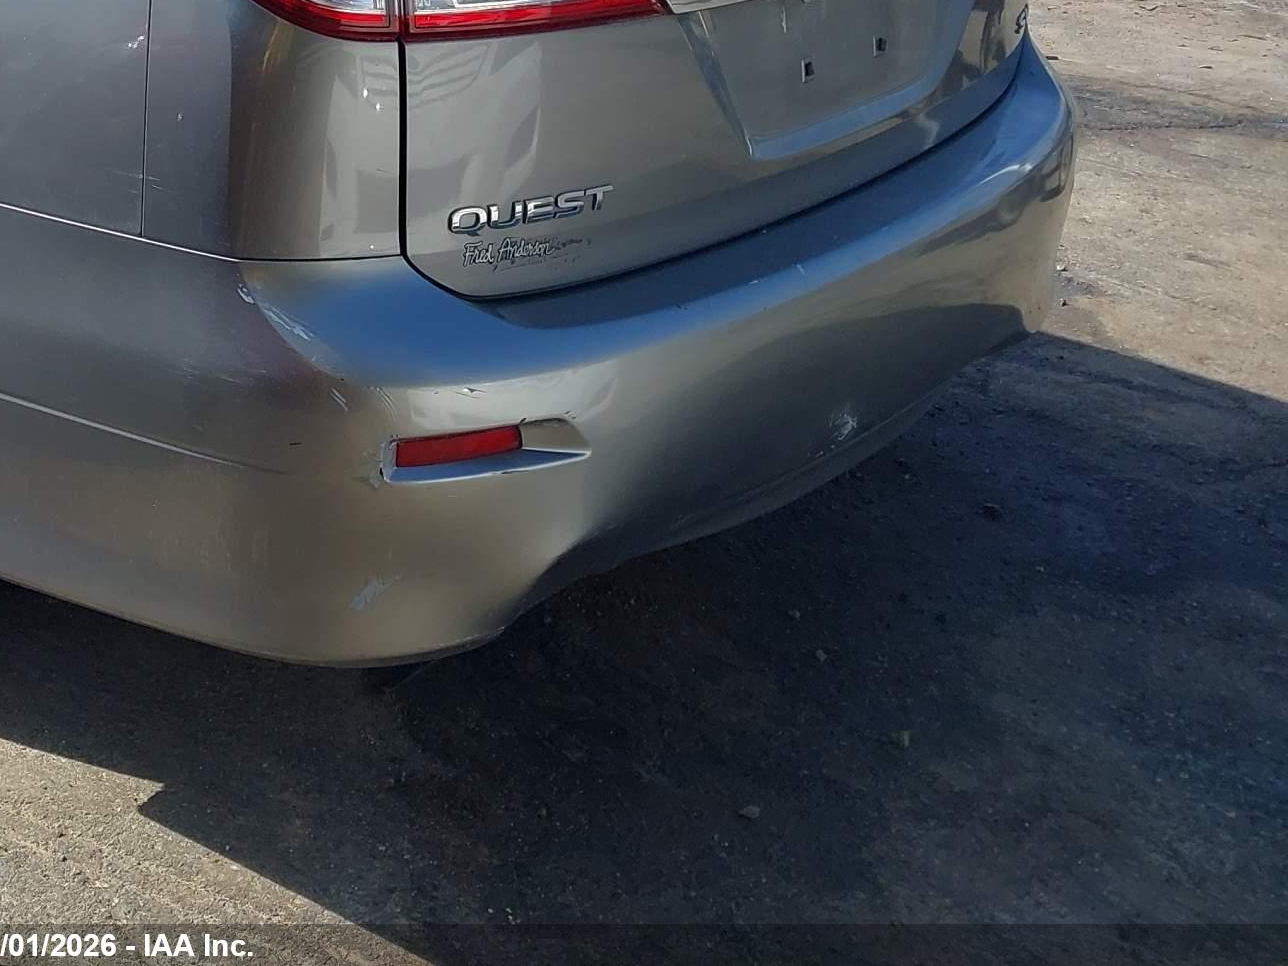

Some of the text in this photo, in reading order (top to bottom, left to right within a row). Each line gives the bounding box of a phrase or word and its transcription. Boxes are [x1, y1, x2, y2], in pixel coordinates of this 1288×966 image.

[447, 184, 614, 237] QUEST
[462, 240, 495, 267] Fred
[497, 236, 554, 262] Anderson
